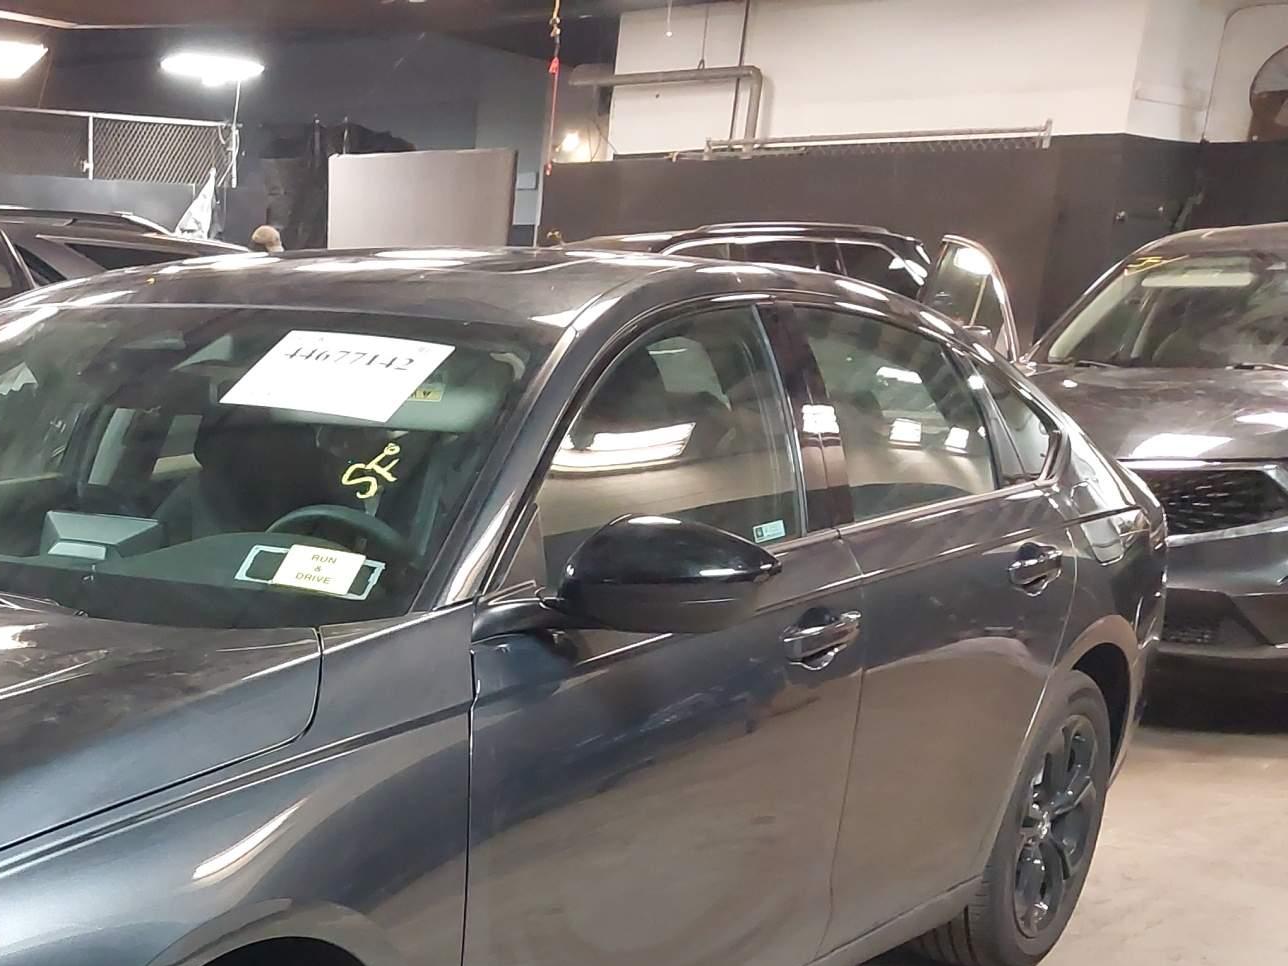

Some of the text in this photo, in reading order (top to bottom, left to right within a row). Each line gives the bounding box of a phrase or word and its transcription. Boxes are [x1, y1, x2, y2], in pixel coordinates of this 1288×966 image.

[285, 347, 415, 371] 44677142
[311, 554, 338, 564] RUN
[313, 565, 322, 573] &
[295, 572, 332, 585] DRIVE
